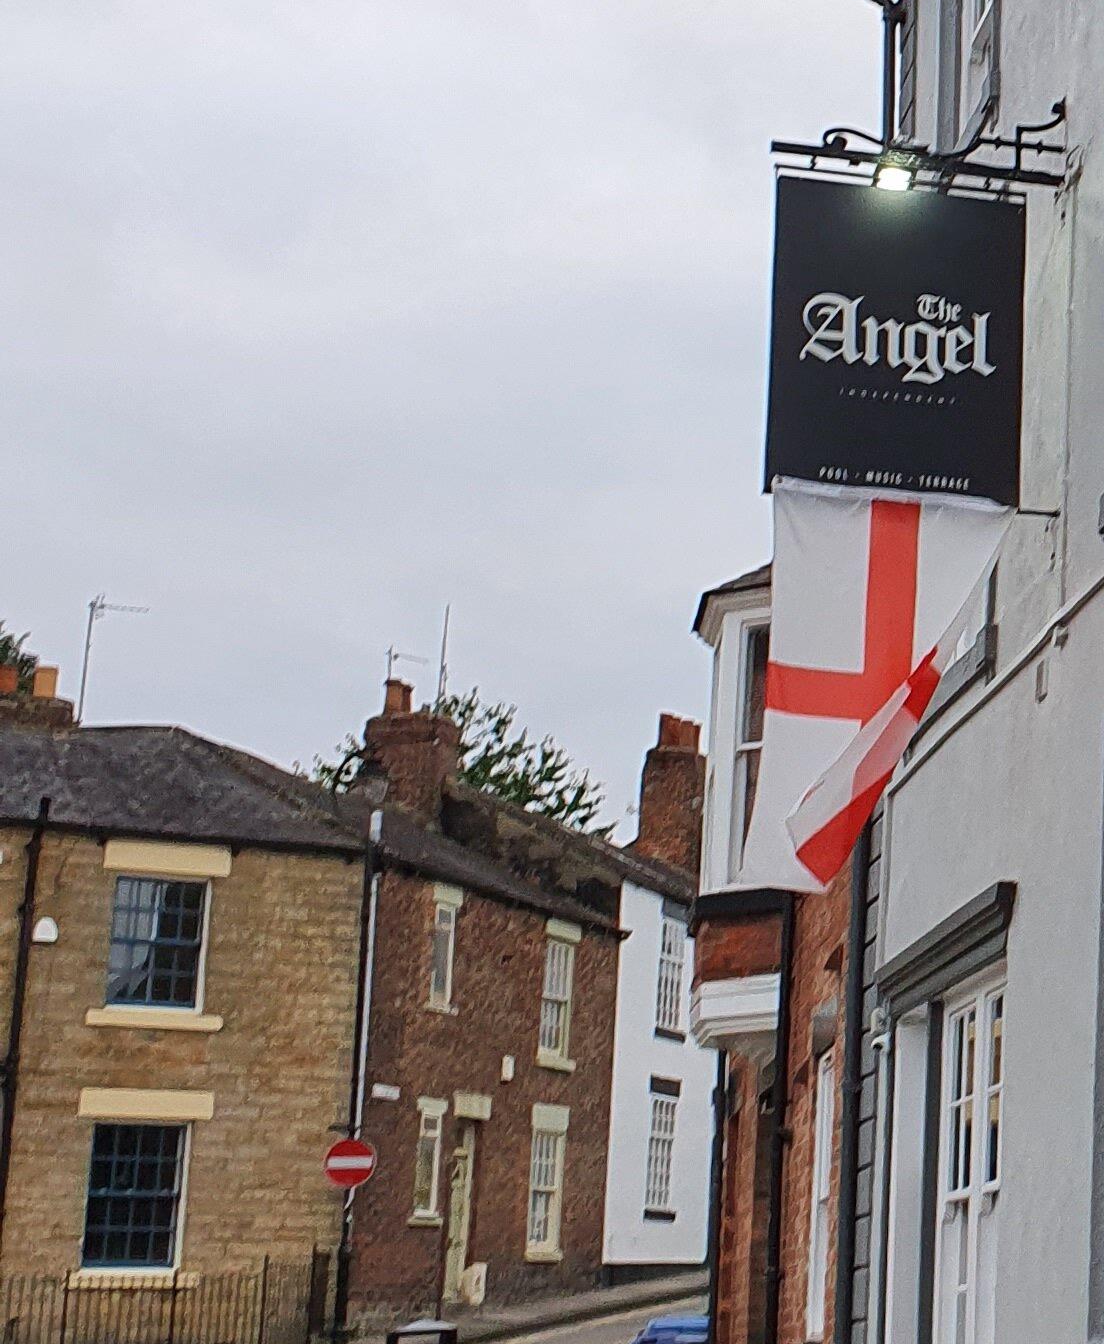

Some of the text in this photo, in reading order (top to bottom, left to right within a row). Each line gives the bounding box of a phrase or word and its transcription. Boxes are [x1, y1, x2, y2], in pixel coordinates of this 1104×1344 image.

[917, 293, 962, 324] The
[799, 292, 997, 384] Angel
[865, 470, 903, 486] MUSIC
